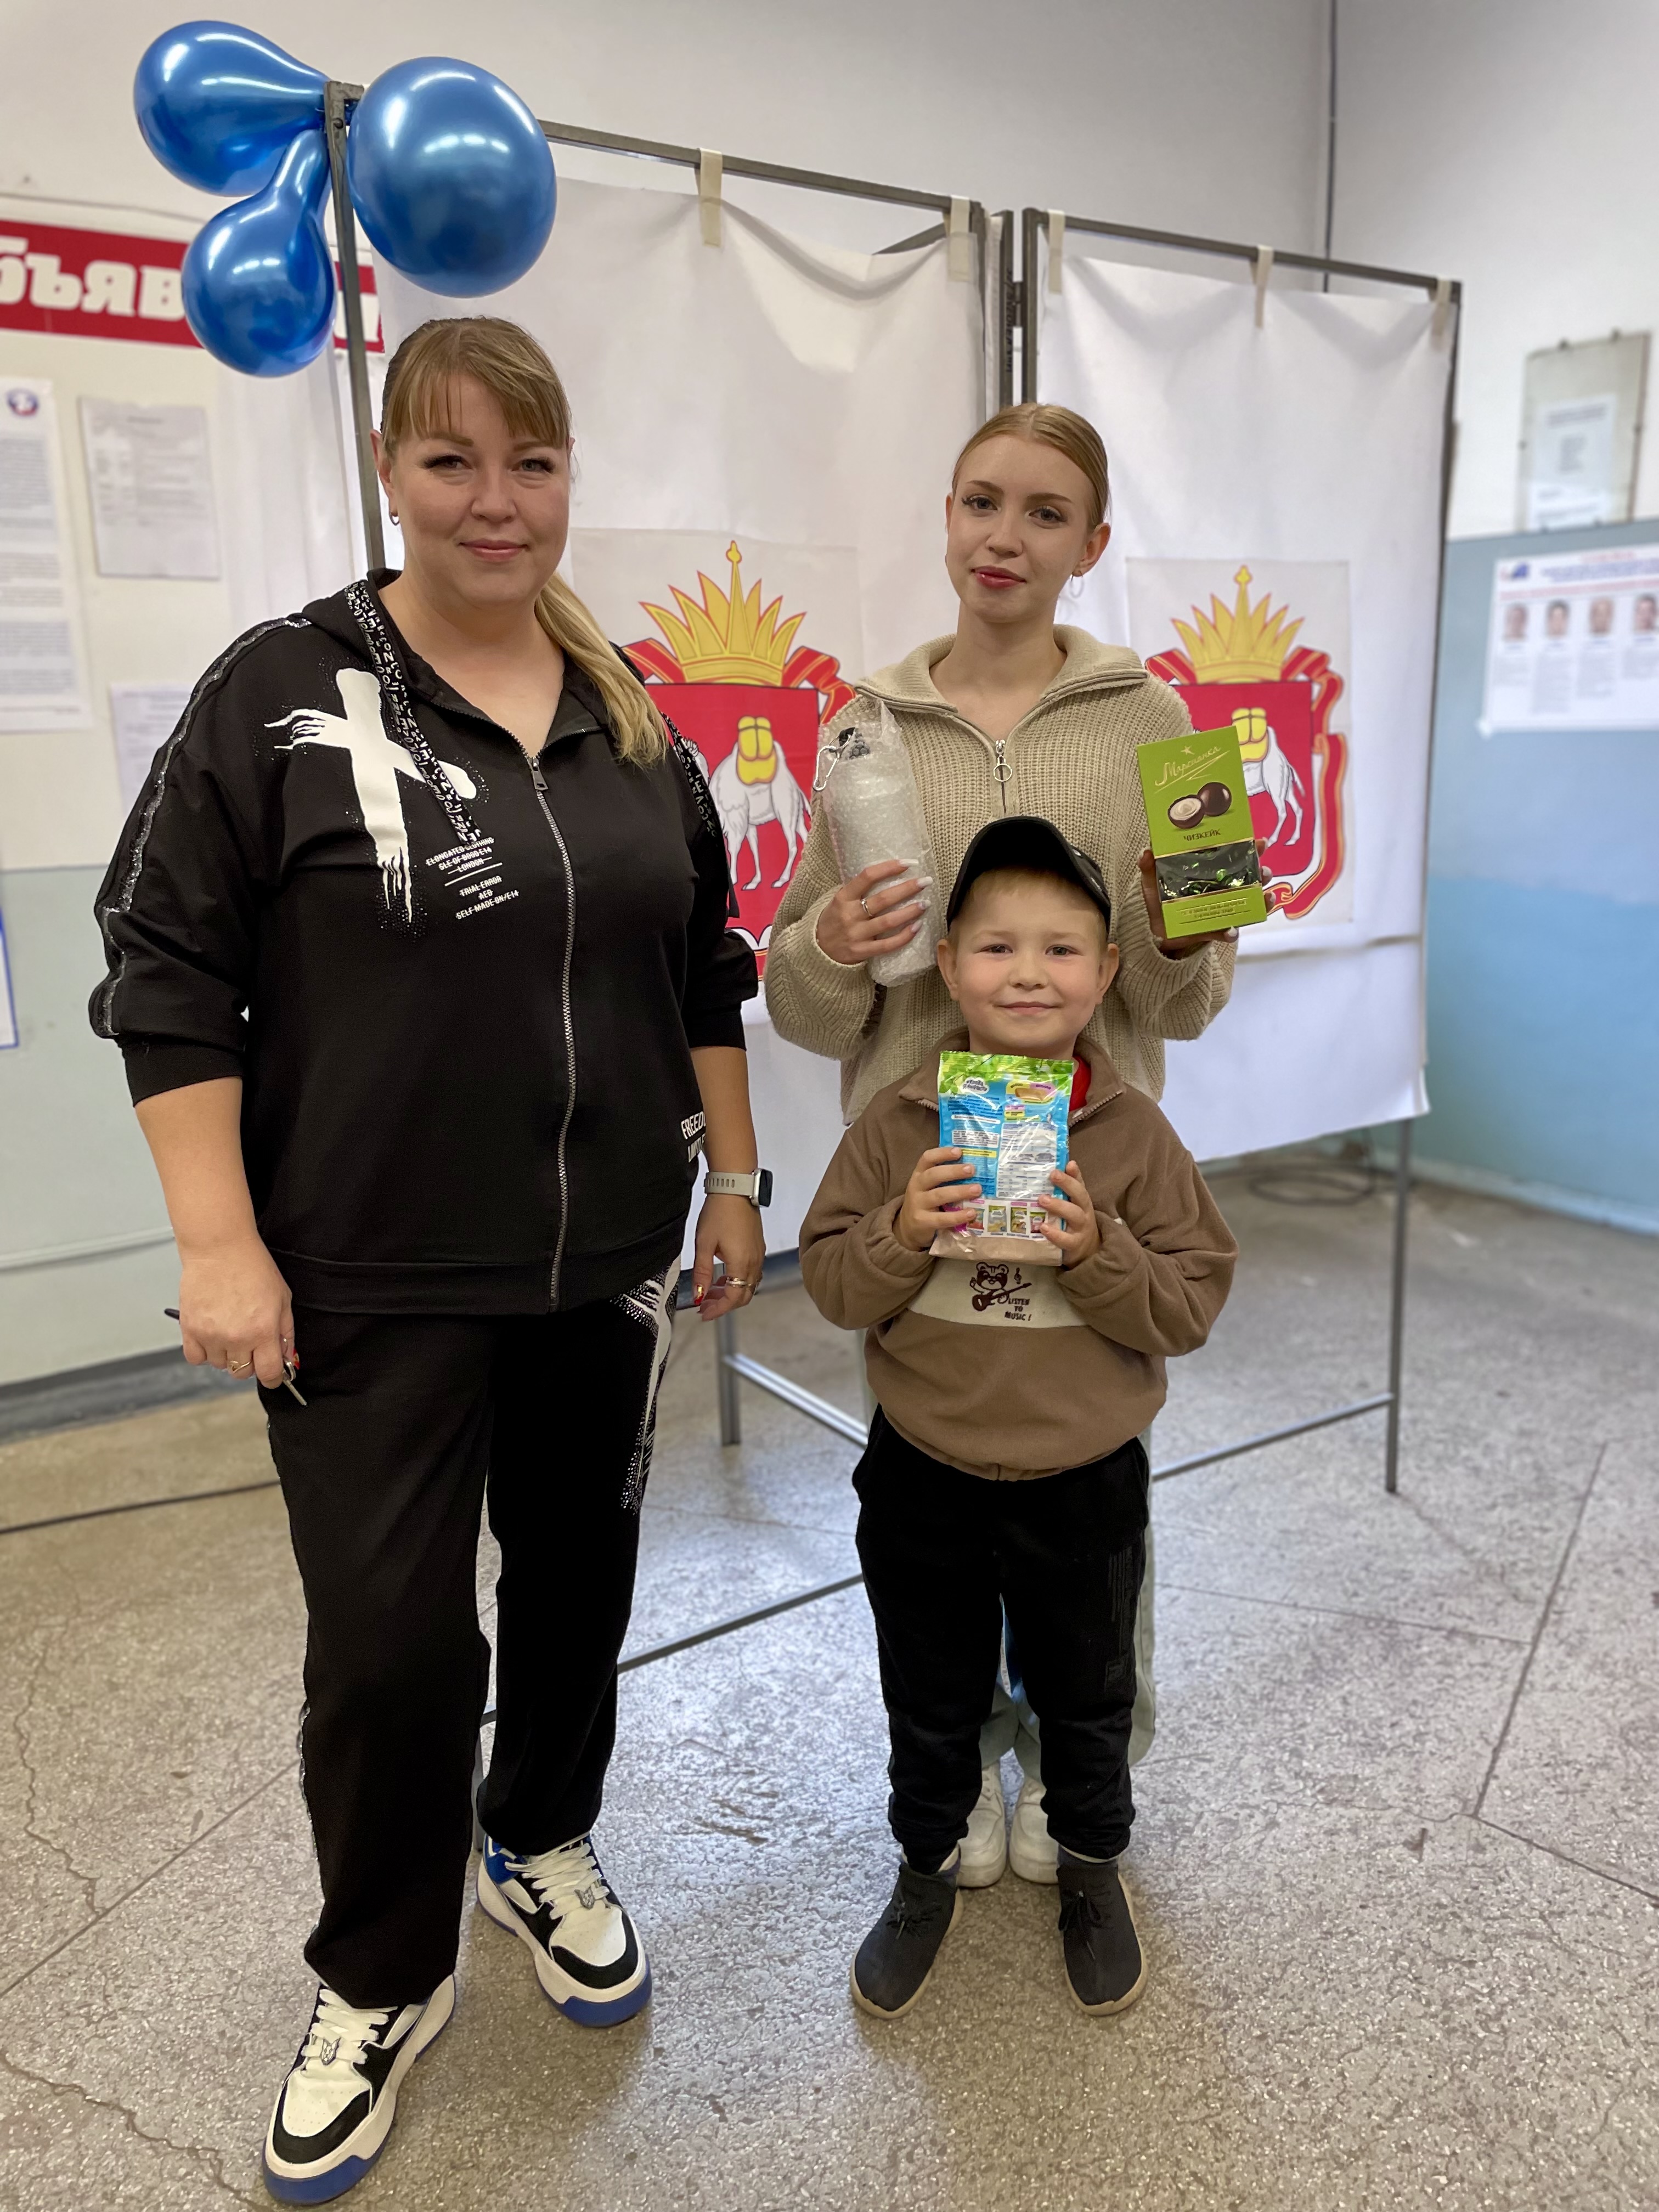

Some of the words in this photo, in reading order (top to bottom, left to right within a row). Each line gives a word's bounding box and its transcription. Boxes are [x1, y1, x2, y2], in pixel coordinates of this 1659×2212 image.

[1183, 828, 1221, 841] ЧИЗКЕЙК
[458, 857, 484, 872] LONDON
[460, 884, 479, 896] TRIAL
[479, 875, 502, 889] ERROR
